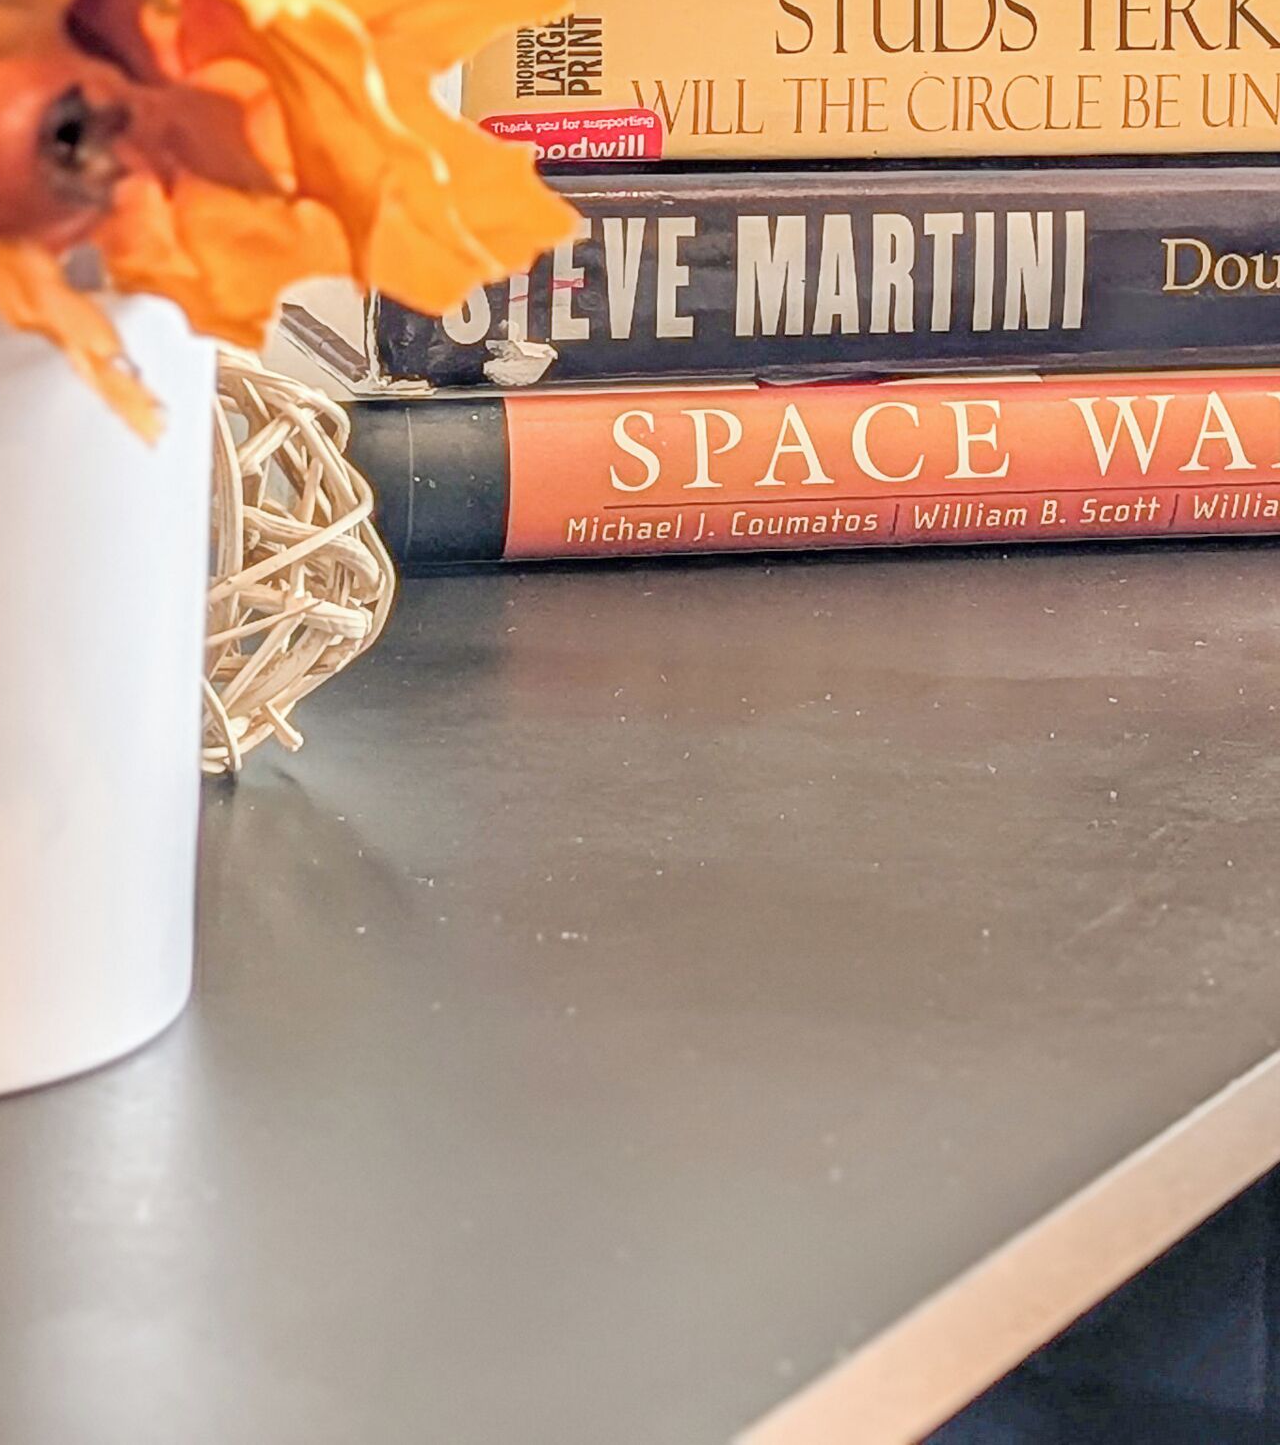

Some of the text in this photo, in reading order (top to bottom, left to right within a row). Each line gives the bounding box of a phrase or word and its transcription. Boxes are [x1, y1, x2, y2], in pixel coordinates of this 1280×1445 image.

[516, 27, 535, 98] THORNDI
[567, 14, 602, 95] PRINT
[491, 115, 655, 134] Thank you for supporting
[631, 79, 763, 136] WILL
[783, 78, 888, 134] THE
[907, 74, 1102, 133] CIRCLE
[1121, 74, 1181, 129] BE
[535, 134, 645, 159] oodwill
[735, 210, 1086, 336] MARTINI
[609, 400, 1010, 492] SPACE
[567, 515, 683, 544] Michael
[694, 513, 715, 541] J.
[731, 507, 878, 536] Coumatos
[914, 502, 1028, 529] William
[1040, 499, 1066, 525] B.
[1080, 496, 1161, 523] Scott
